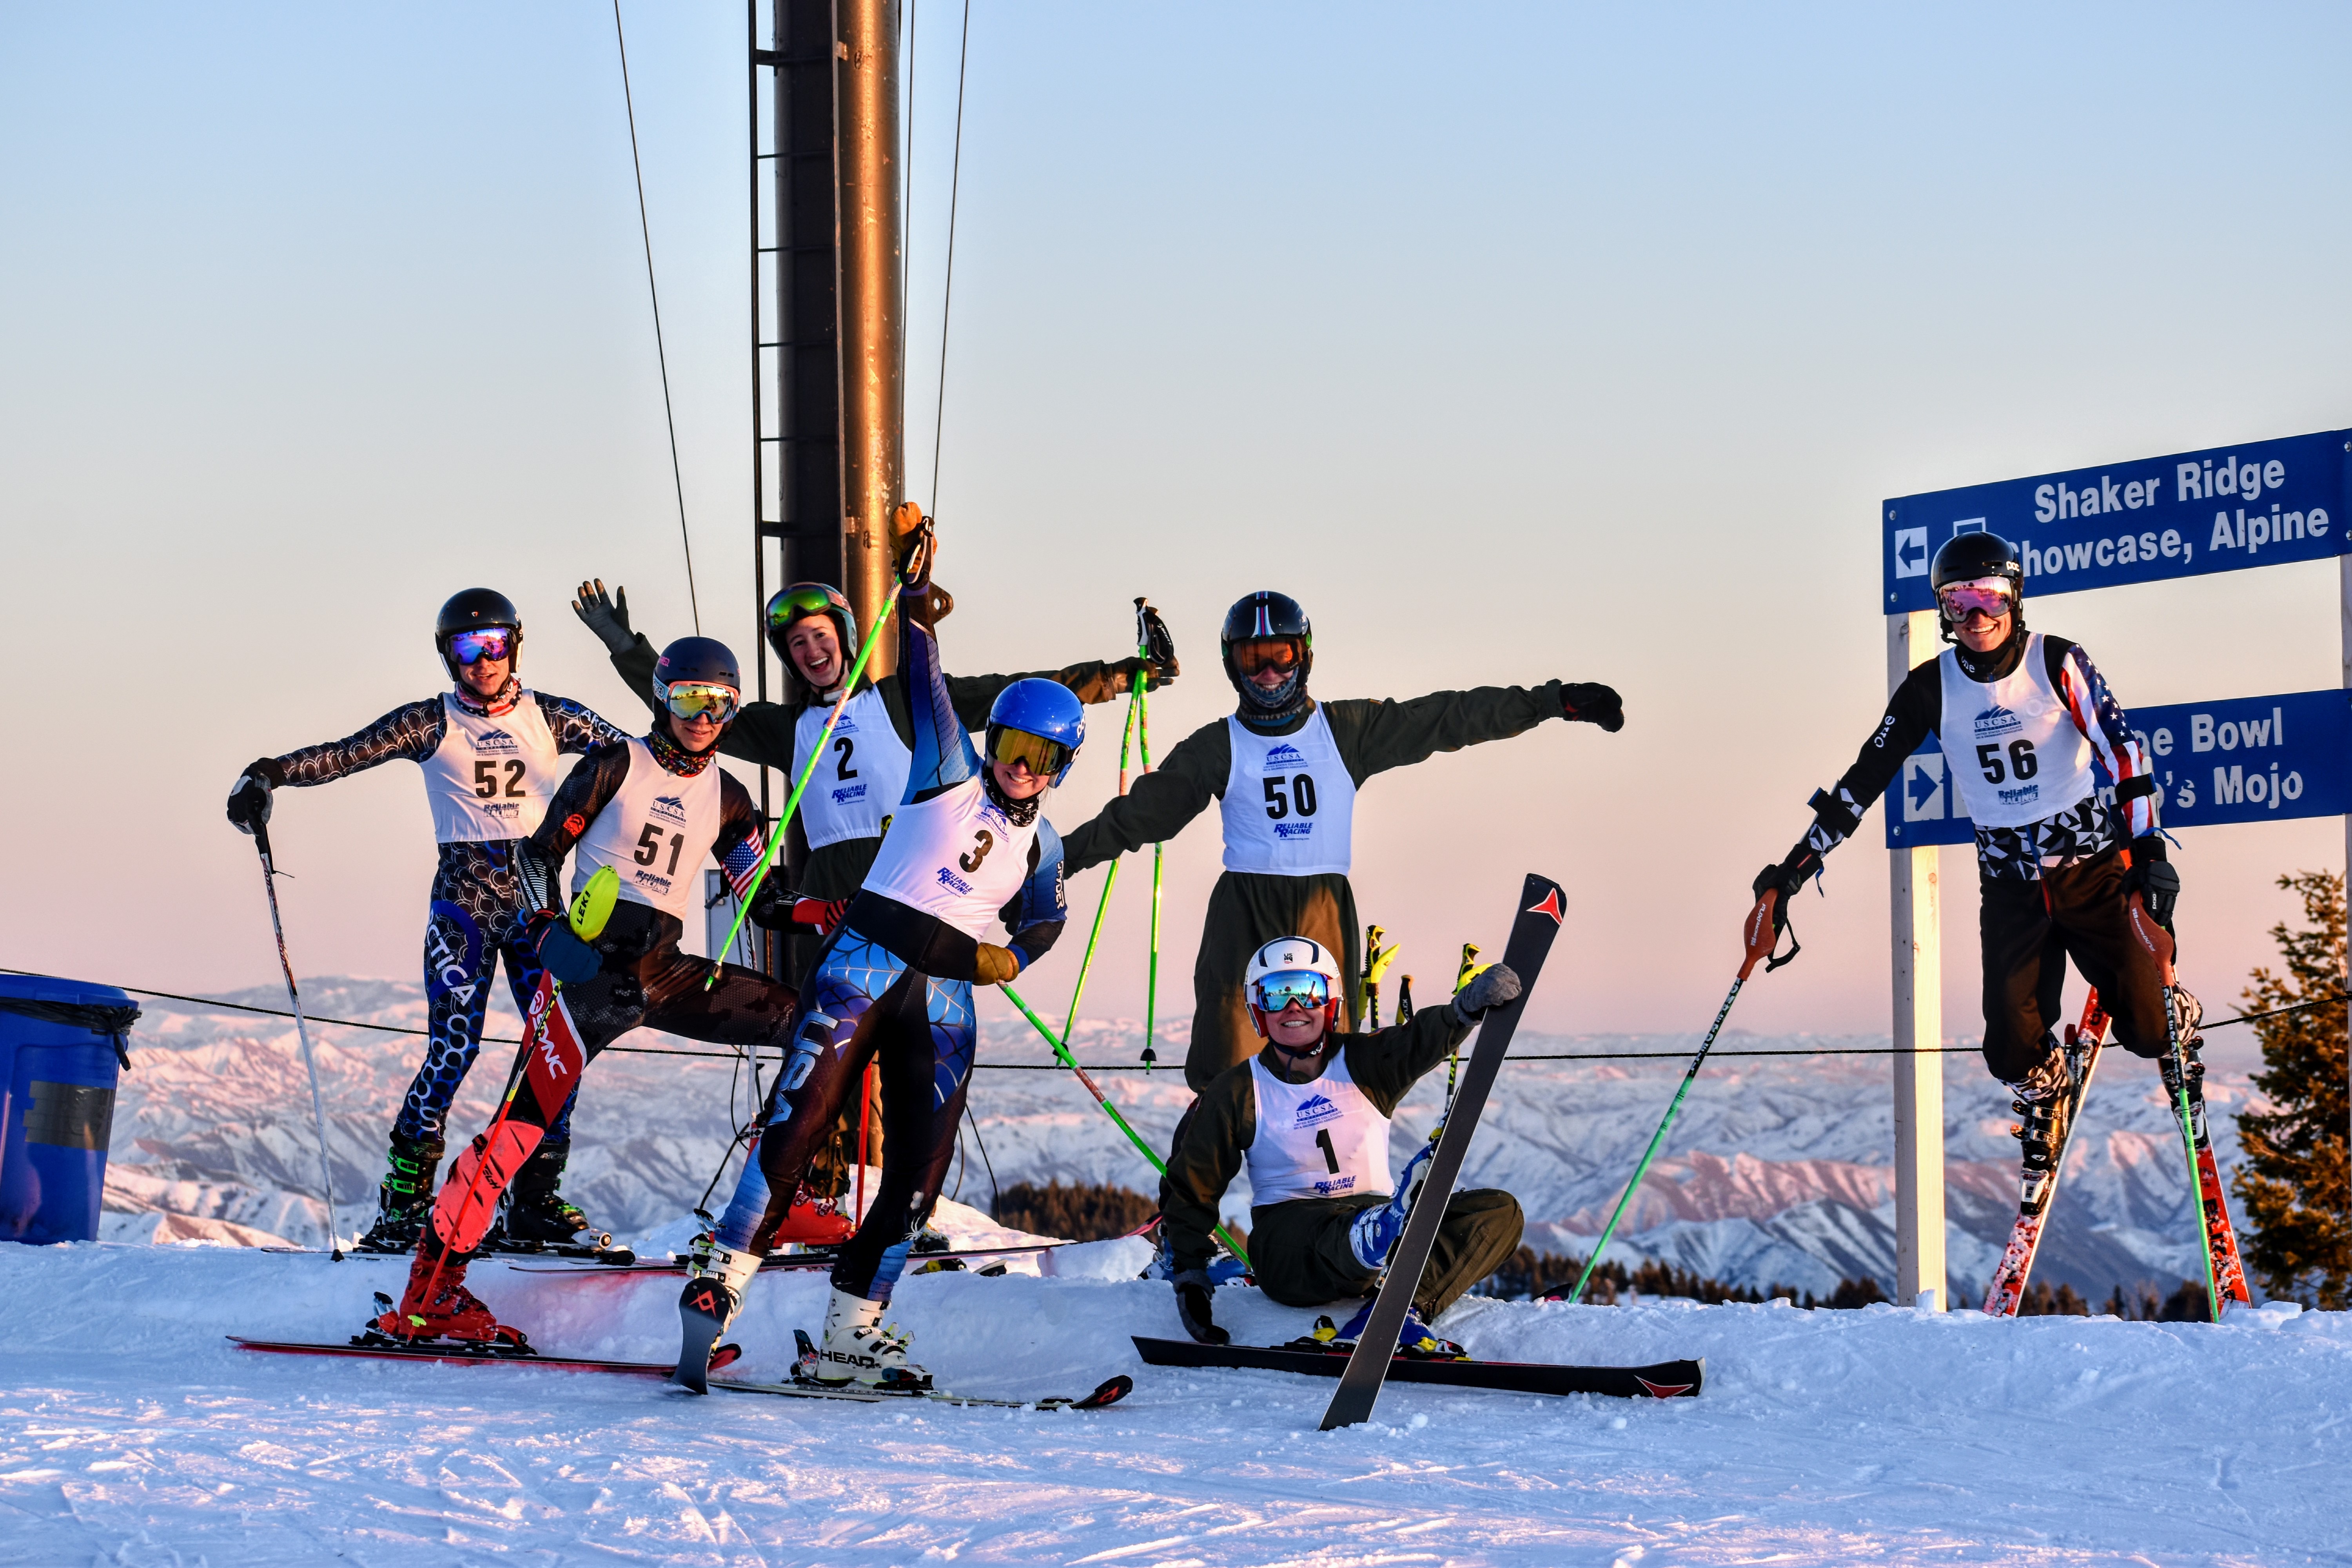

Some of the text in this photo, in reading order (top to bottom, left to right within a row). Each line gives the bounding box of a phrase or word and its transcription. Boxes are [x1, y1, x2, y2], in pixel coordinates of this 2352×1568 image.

[2035, 456, 2285, 523] Shaker Ridge
[2007, 505, 2330, 577] howcase, Alpine
[2006, 561, 2020, 572] poc
[1975, 715, 2016, 728] USCSA
[2191, 707, 2283, 752] Bowl
[477, 739, 514, 747] USCSA
[833, 737, 858, 781] 2
[1267, 753, 1301, 762] USCSA
[1976, 739, 2038, 784] 56
[475, 759, 526, 798] 52
[2213, 762, 2303, 809] Mojo
[831, 784, 867, 799] RELIABLE
[837, 790, 866, 803] RACING
[1263, 773, 1317, 819] 50
[1998, 784, 2038, 797] Reliable
[1999, 791, 2038, 805] RACING
[483, 809, 520, 817] RACING
[653, 800, 684, 818] USCSA
[984, 807, 1005, 831] USCSA
[1274, 822, 1313, 833] RELIABLE
[1279, 828, 1311, 837] RACING
[634, 822, 684, 876] 51
[959, 830, 993, 873] 3
[633, 876, 669, 894] RACING
[635, 869, 672, 886] Reliable
[936, 867, 974, 892] RELIABLE
[937, 875, 969, 895] RACING
[576, 890, 591, 926] LEKI
[426, 908, 477, 1006] CTICA
[532, 1013, 568, 1080] SYNC
[767, 1009, 840, 1127] USA
[1296, 1103, 1334, 1118] USCSA
[1316, 1128, 1339, 1175] 1
[1313, 1175, 1357, 1189] RELIABLE
[1319, 1181, 1354, 1194] RACING
[819, 1349, 875, 1368] HEAD
